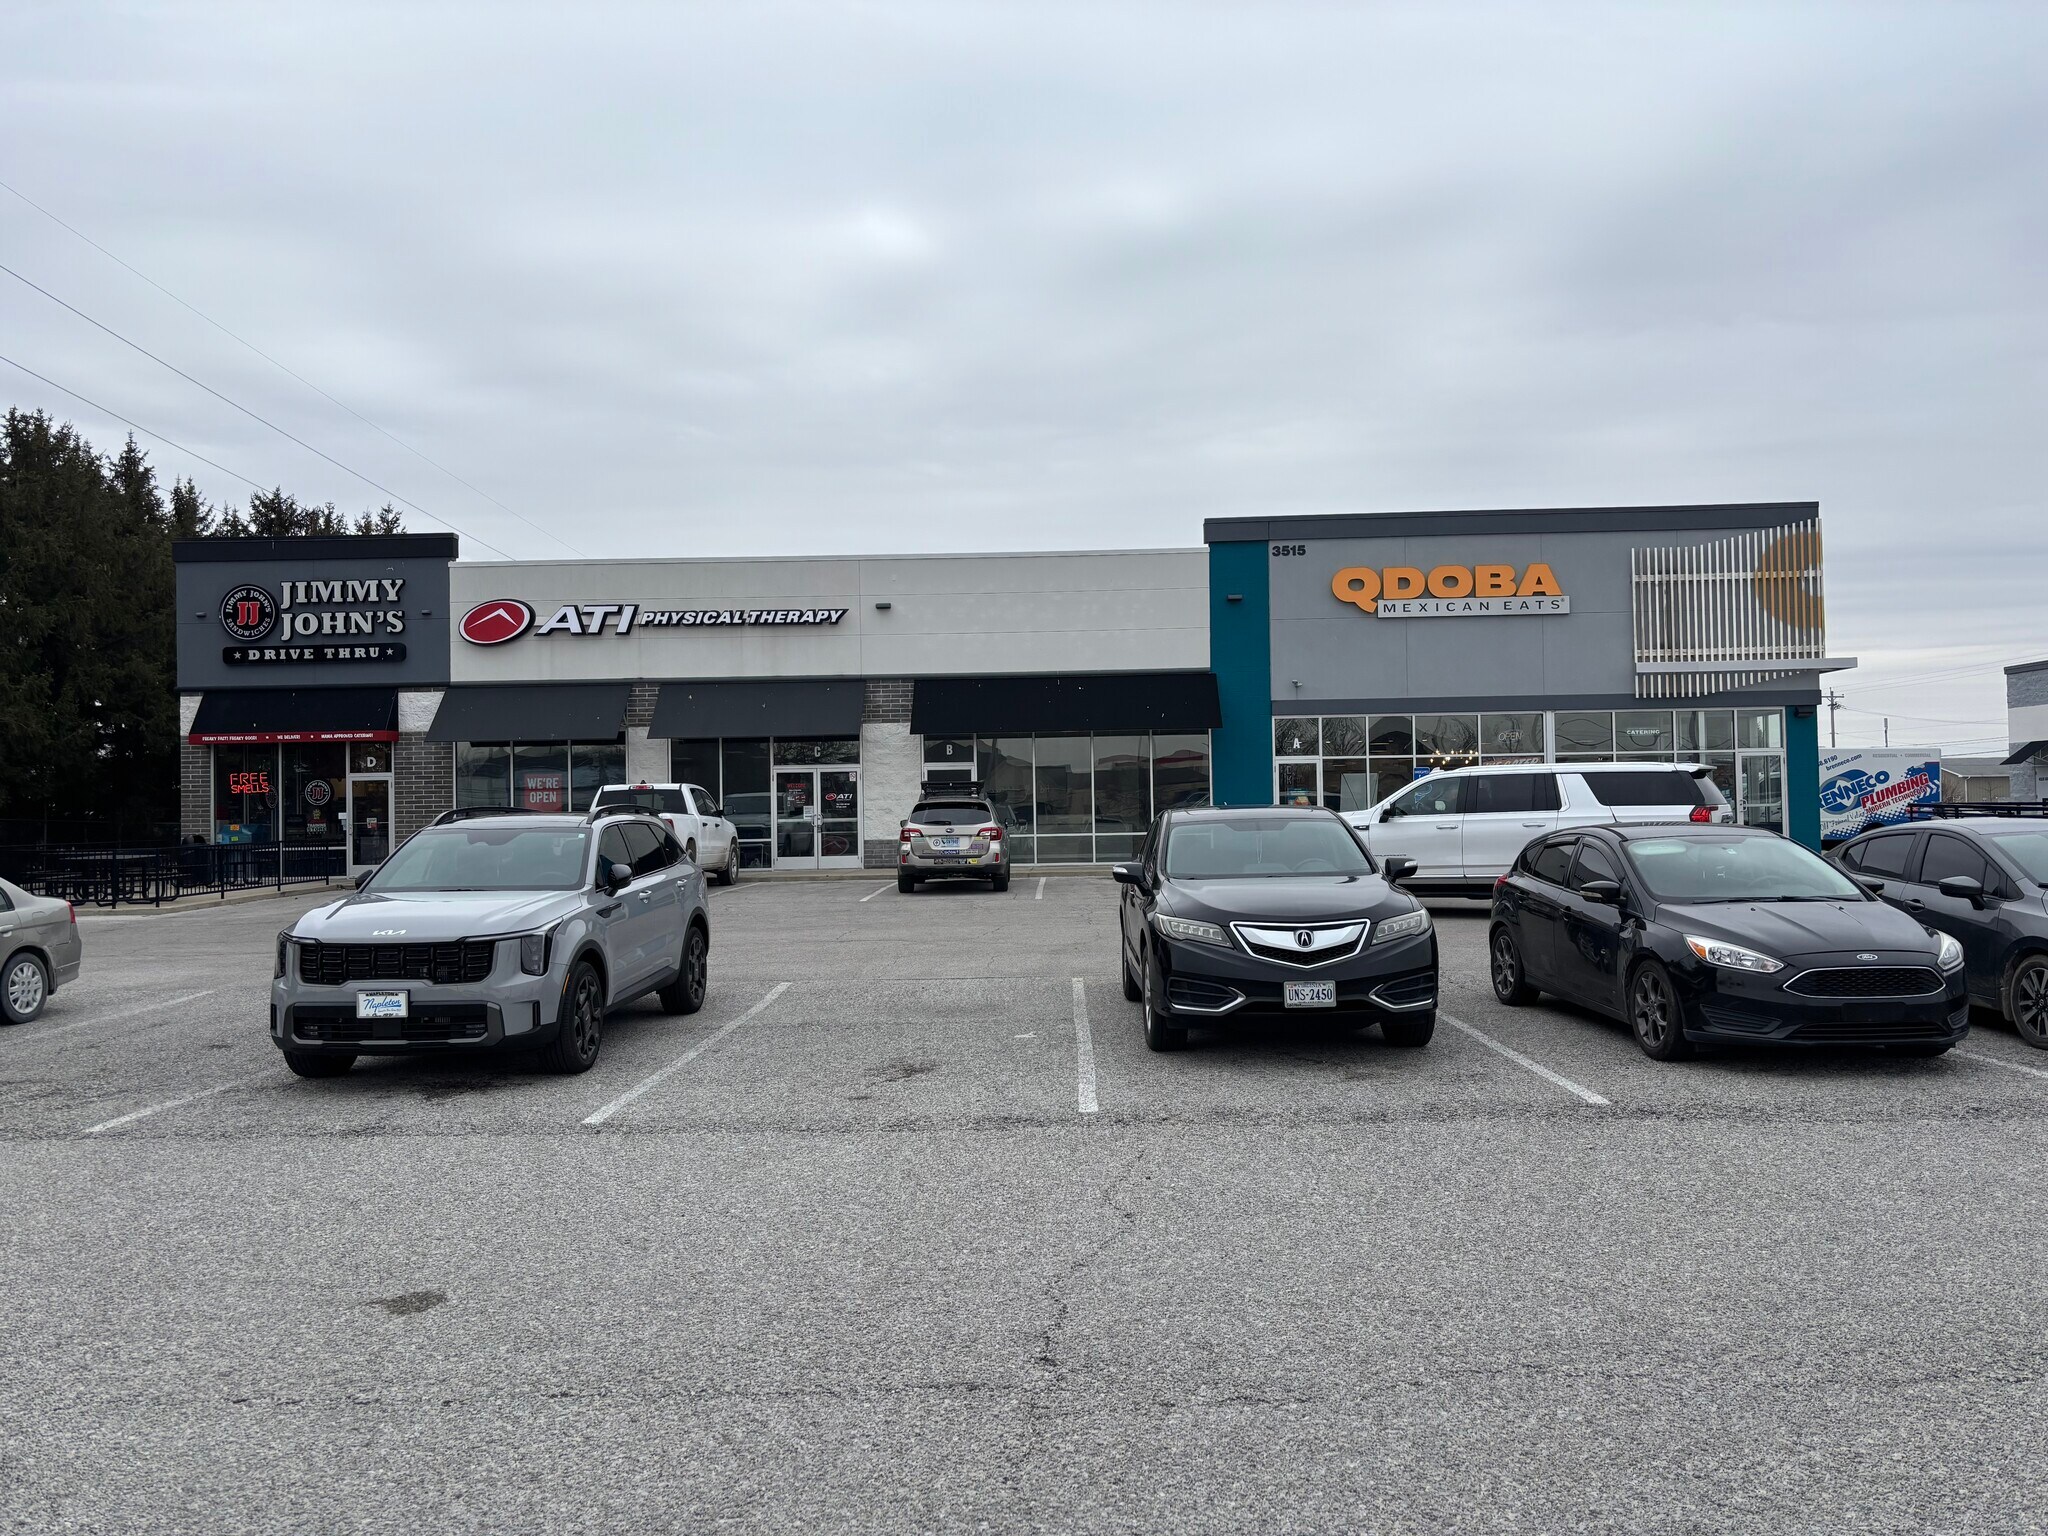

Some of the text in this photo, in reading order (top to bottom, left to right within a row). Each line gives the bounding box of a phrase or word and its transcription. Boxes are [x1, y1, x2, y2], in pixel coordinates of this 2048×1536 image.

[1272, 545, 1306, 556] 3515
[280, 579, 404, 609] JIMMY
[1331, 563, 1563, 614] QDOBA
[226, 590, 272, 613] JIMMY JOHN'S
[1383, 600, 1560, 613] MEXICAN EATS
[237, 602, 260, 625] JJ
[533, 604, 849, 636] ATI PHYSICAL THERAPY
[226, 617, 271, 637] SANDWICHES
[281, 610, 404, 640] JOHN'S
[248, 647, 380, 660] DRIVE THRU
[1498, 732, 1522, 741] OPEN
[946, 744, 953, 755] B
[1293, 738, 1300, 749] A
[814, 746, 821, 757] C
[366, 756, 376, 768] D
[229, 772, 268, 785] FREE
[527, 777, 559, 789] WE'RE
[230, 783, 270, 794] SMELLS
[1860, 772, 1929, 809] PLUMBING
[529, 791, 557, 803] OPEN
[1865, 801, 1891, 815] MODERN
[1288, 988, 1333, 1001] UNS-2450
[363, 995, 402, 1013] Napleton
